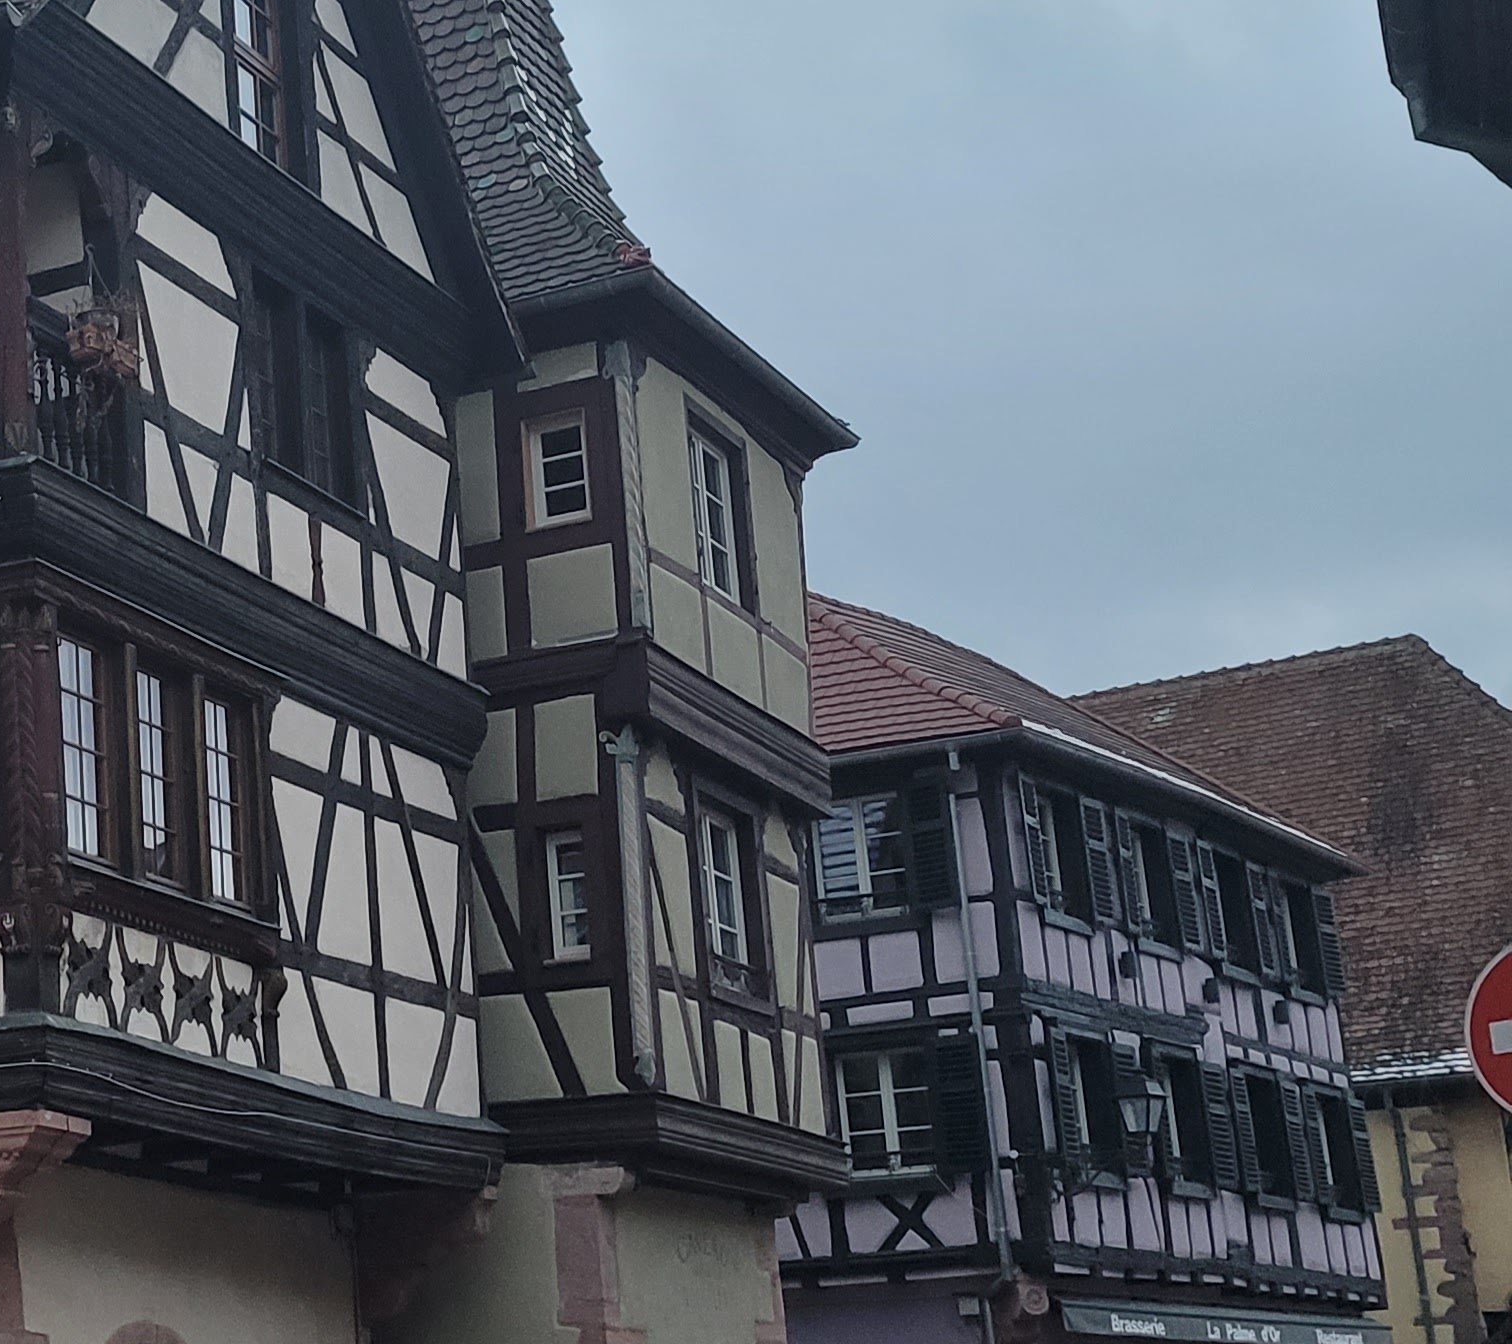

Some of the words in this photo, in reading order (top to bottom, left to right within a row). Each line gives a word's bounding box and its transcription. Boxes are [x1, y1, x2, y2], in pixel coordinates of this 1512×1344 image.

[1110, 1313, 1167, 1336] Brasserie
[1206, 1320, 1222, 1339] La
[1225, 1322, 1257, 1343] Palme
